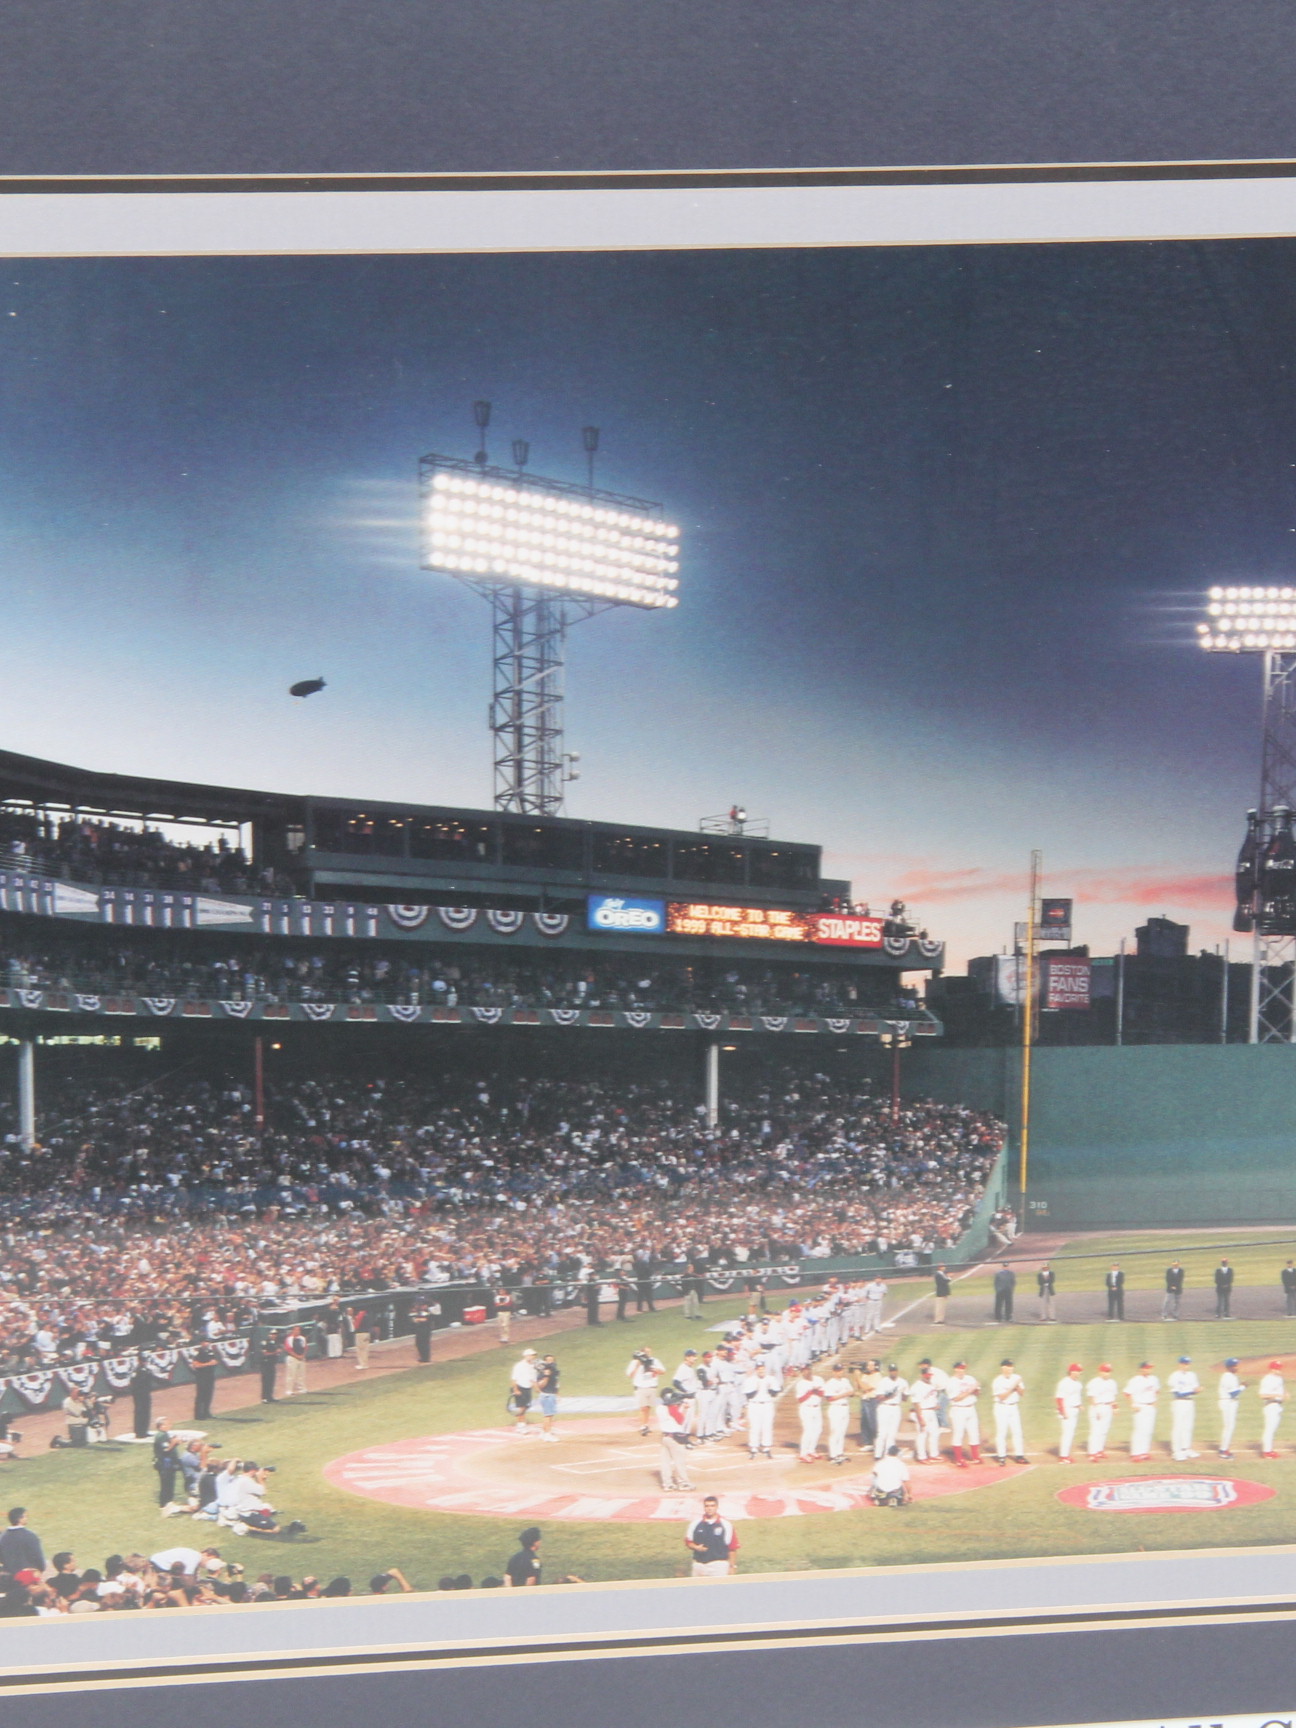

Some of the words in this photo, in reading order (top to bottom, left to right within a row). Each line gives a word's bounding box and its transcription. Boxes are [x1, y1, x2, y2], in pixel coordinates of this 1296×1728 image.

[596, 908, 660, 928] OREO
[688, 904, 741, 921] WELCOME
[747, 908, 764, 922] TO
[768, 910, 793, 924] THE
[675, 919, 706, 933] 1999
[819, 918, 881, 942] STAPLES
[1048, 964, 1091, 975] BOSTON
[1048, 976, 1090, 992] FANS
[1048, 993, 1090, 1003] FAVORITE
[1028, 1201, 1048, 1209] 310
